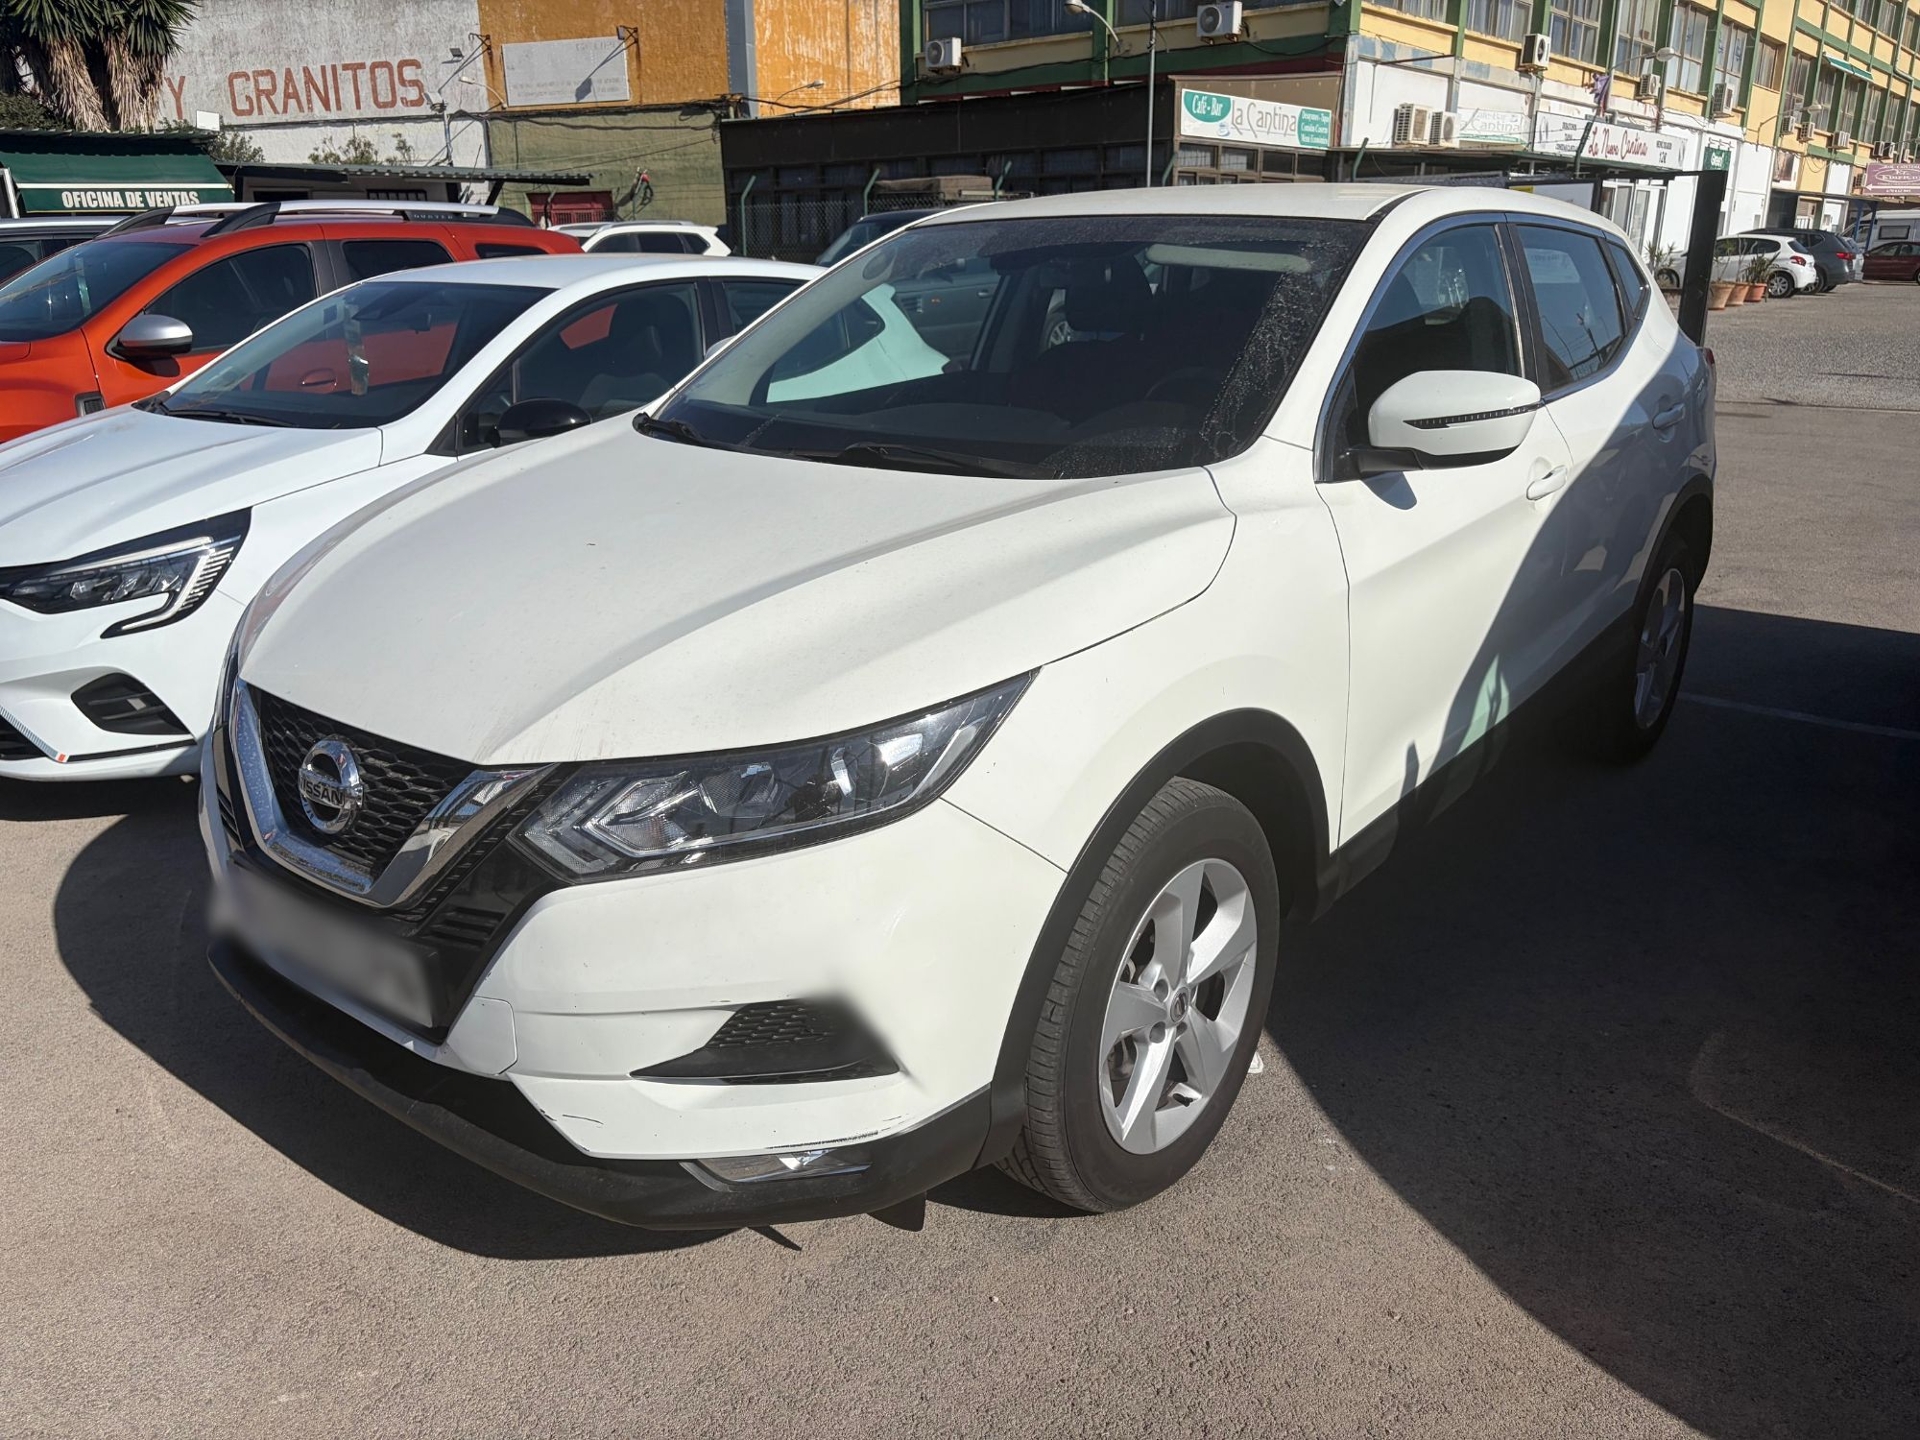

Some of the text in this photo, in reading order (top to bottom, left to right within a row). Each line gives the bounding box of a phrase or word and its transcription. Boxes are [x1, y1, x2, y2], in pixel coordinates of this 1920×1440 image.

[164, 58, 425, 120] Y GRANITOS
[1231, 99, 1297, 138] La Cantina
[1620, 130, 1648, 160] Cantina
[61, 190, 200, 208] OFICINA DE VENTAS
